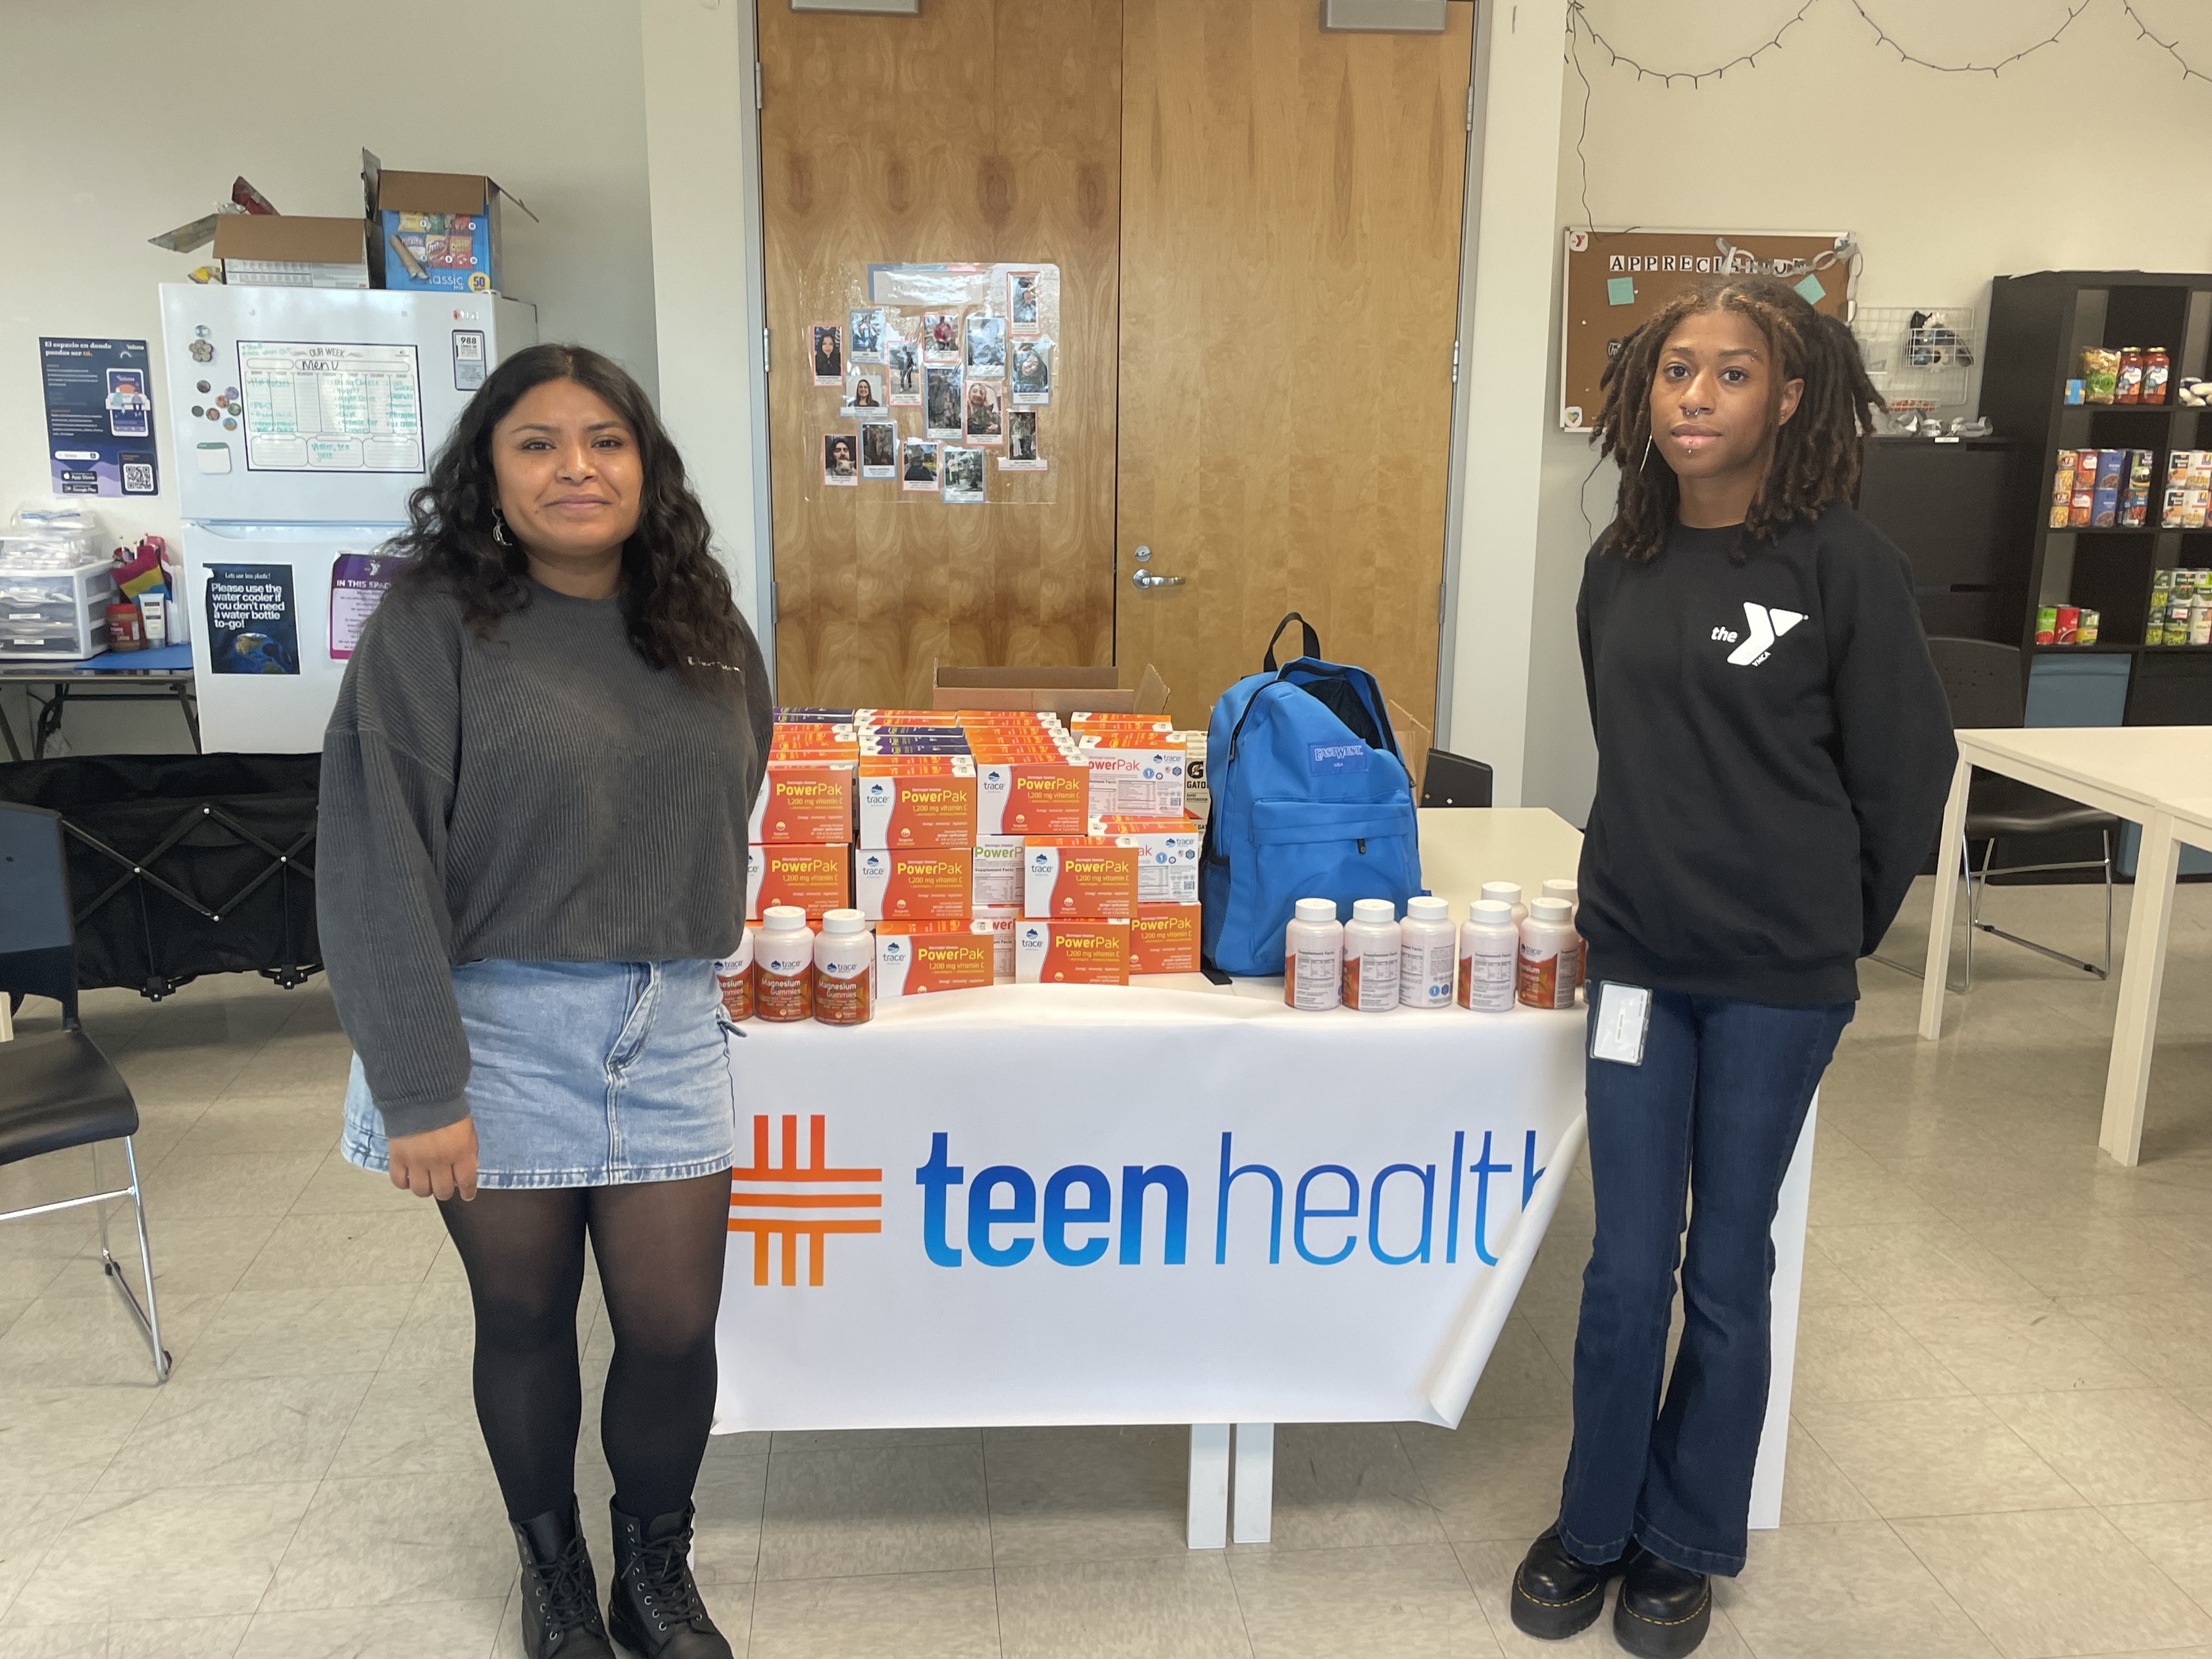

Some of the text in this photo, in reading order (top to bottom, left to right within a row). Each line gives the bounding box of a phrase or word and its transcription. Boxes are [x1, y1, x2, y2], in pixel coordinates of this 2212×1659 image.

[429, 274, 463, 285] lassic
[473, 276, 485, 287] 50
[309, 348, 345, 357] OUR WEEK
[211, 583, 244, 592] Please
[265, 584, 281, 593] the
[348, 579, 366, 588] THIS
[242, 593, 274, 601] cooler
[275, 592, 281, 601] if
[212, 601, 285, 611] you don't need
[222, 611, 250, 619] water
[251, 611, 280, 620] bottle
[215, 619, 245, 630] to-go!
[1711, 626, 1737, 642] the
[1752, 651, 1771, 667] YMCA
[1089, 759, 1139, 771] owerPak
[1187, 761, 1204, 778] G
[984, 782, 1003, 790] trace
[1017, 777, 1080, 789] PowerPak
[1187, 781, 1206, 789] GATO
[776, 783, 843, 795] PowerPak
[901, 790, 967, 803] PowerPak
[975, 847, 1023, 858] PowerP
[772, 860, 838, 872] PowerPak
[897, 862, 962, 874] PowerPak
[1065, 860, 1129, 872] PowerPak
[1131, 917, 1192, 930] PowerPak
[1056, 936, 1119, 949] PowerPak
[918, 947, 984, 961] PowerPak
[1526, 945, 1541, 955] trace
[762, 978, 800, 988] Magnesium
[819, 979, 856, 990] Magnesium
[915, 1132, 1190, 1267] teen
